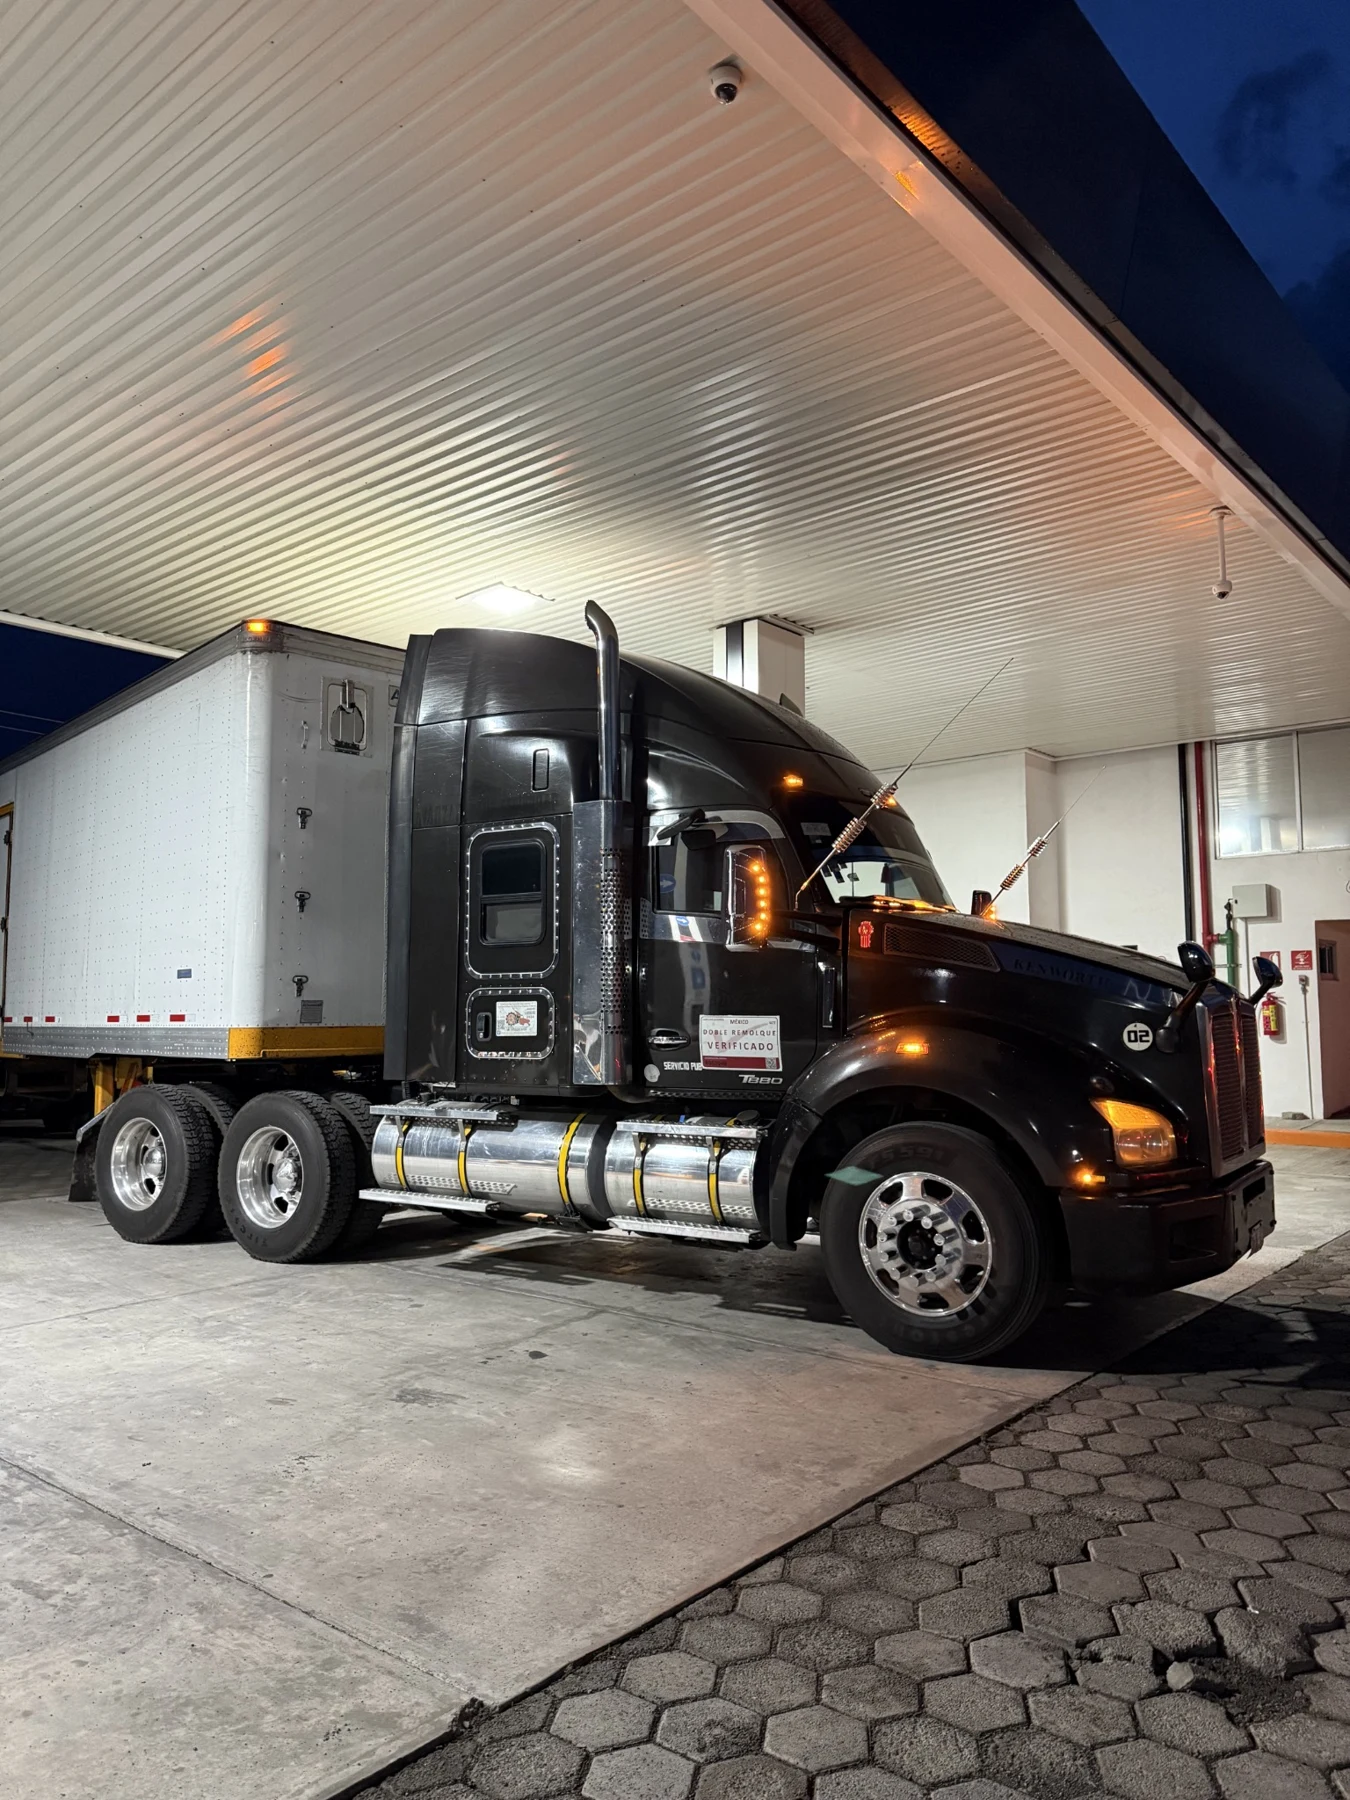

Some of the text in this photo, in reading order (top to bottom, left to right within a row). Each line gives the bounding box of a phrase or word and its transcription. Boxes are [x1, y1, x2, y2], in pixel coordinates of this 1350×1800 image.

[1013, 958, 1113, 987] KENWORTH
[702, 1028, 777, 1037] DOBLE REMOLQUE
[1127, 1030, 1150, 1043] 02
[707, 1041, 774, 1051] VERIFICADO
[663, 1061, 690, 1071] SERVICIO
[738, 1074, 783, 1085] T880
